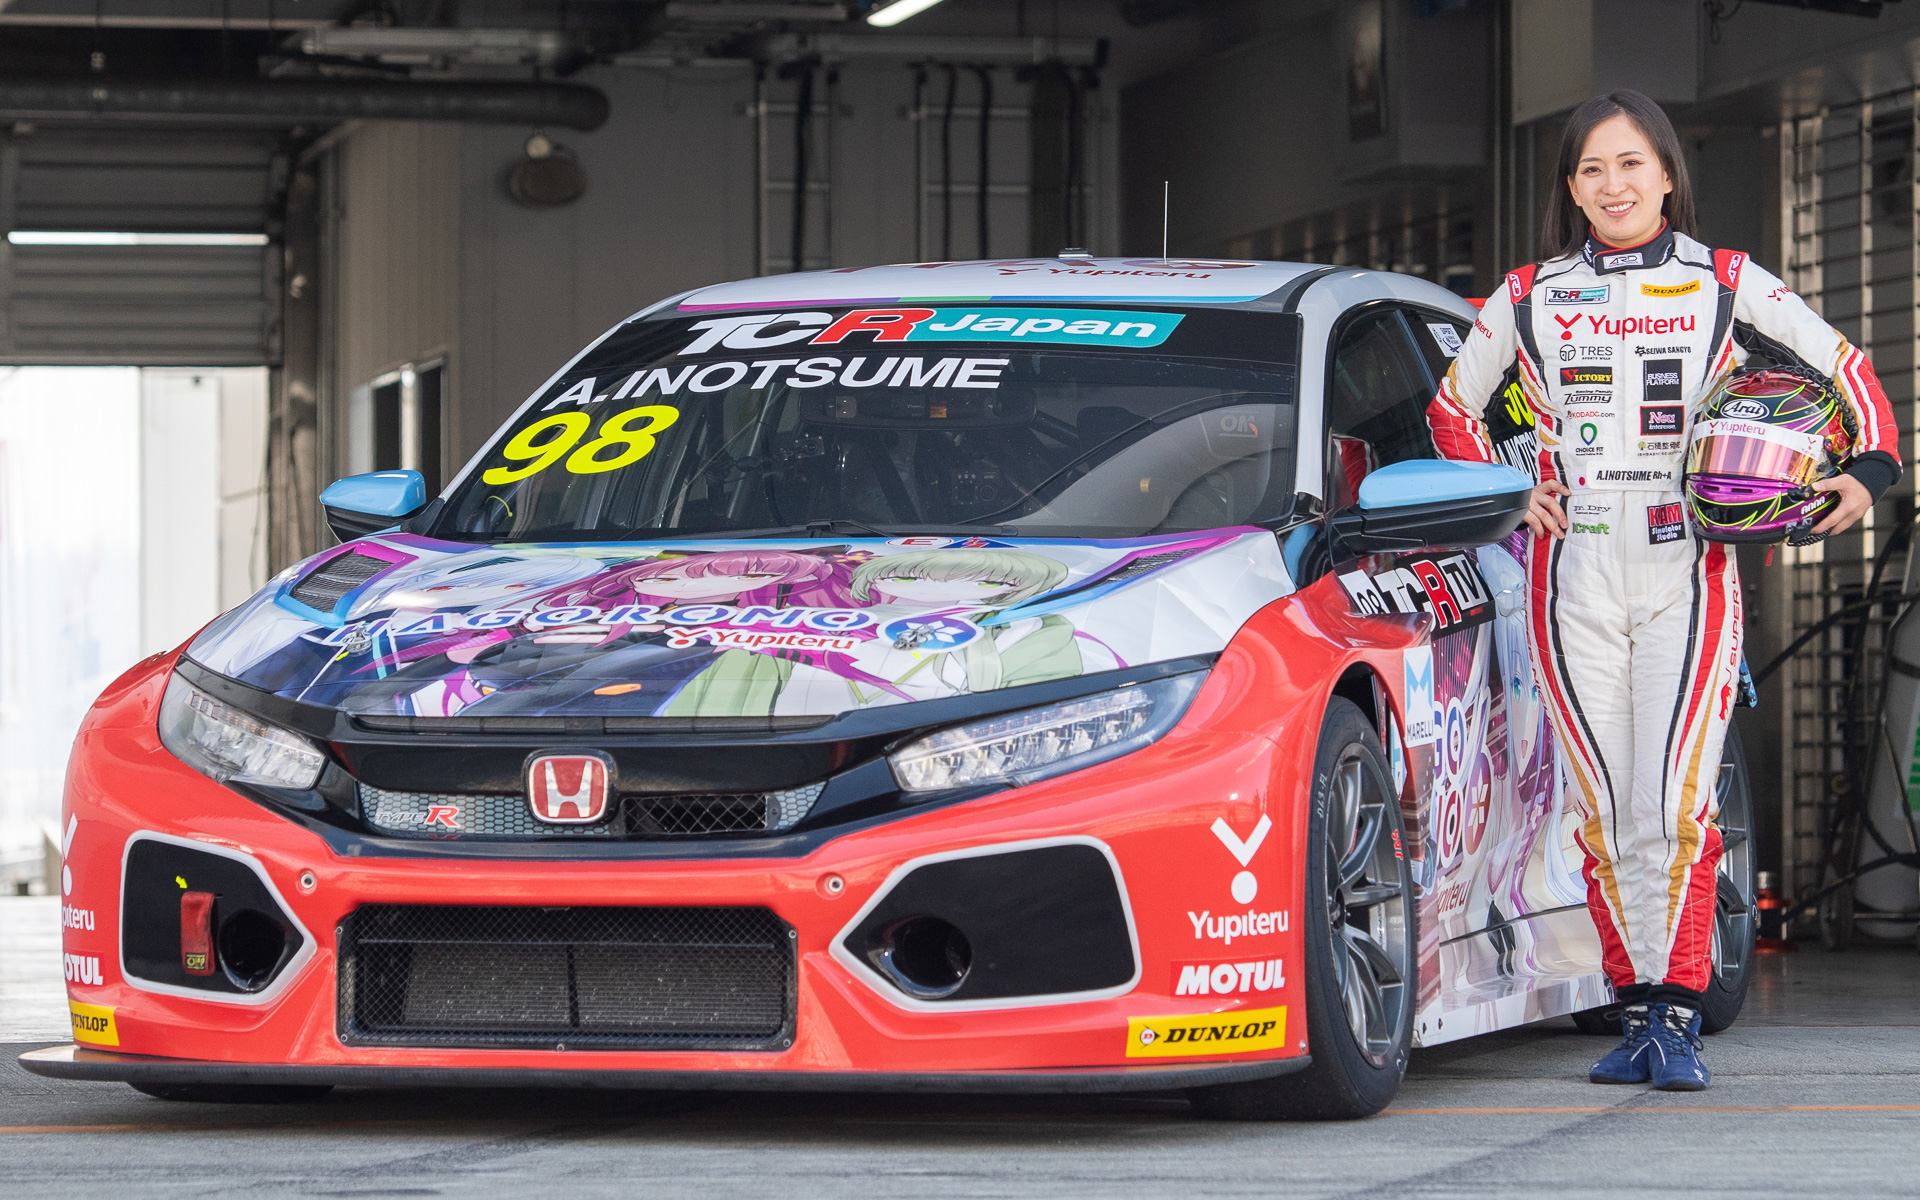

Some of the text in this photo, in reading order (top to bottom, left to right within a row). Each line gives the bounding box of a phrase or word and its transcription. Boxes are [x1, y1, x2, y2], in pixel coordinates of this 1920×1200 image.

[1551, 290, 1580, 299] TCR
[1653, 284, 1696, 294] DUNLOP
[677, 309, 1157, 355] TCR Japan
[1588, 314, 1695, 341] Yupiteru
[1579, 346, 1613, 356] TRES
[541, 357, 1010, 411] A.INOTSUME
[1725, 401, 1763, 415] Arai
[1720, 421, 1766, 436] Yupiteru
[482, 405, 680, 486] 98
[1596, 470, 1672, 481] A.INOTSUME Rh+A
[1648, 503, 1682, 527] KAM
[1652, 525, 1682, 535] Simulator
[1656, 532, 1678, 541] Studio
[1373, 559, 1463, 632] TCR
[716, 631, 853, 649] Yupiteru
[1730, 590, 1741, 668] SUPER
[1407, 721, 1434, 742] MARELLI
[424, 806, 460, 828] R
[1188, 909, 1288, 945] Yupiteru
[64, 953, 103, 985] OTUL
[1175, 959, 1285, 995] MOTUL
[1163, 1020, 1276, 1044] DUNLOP
